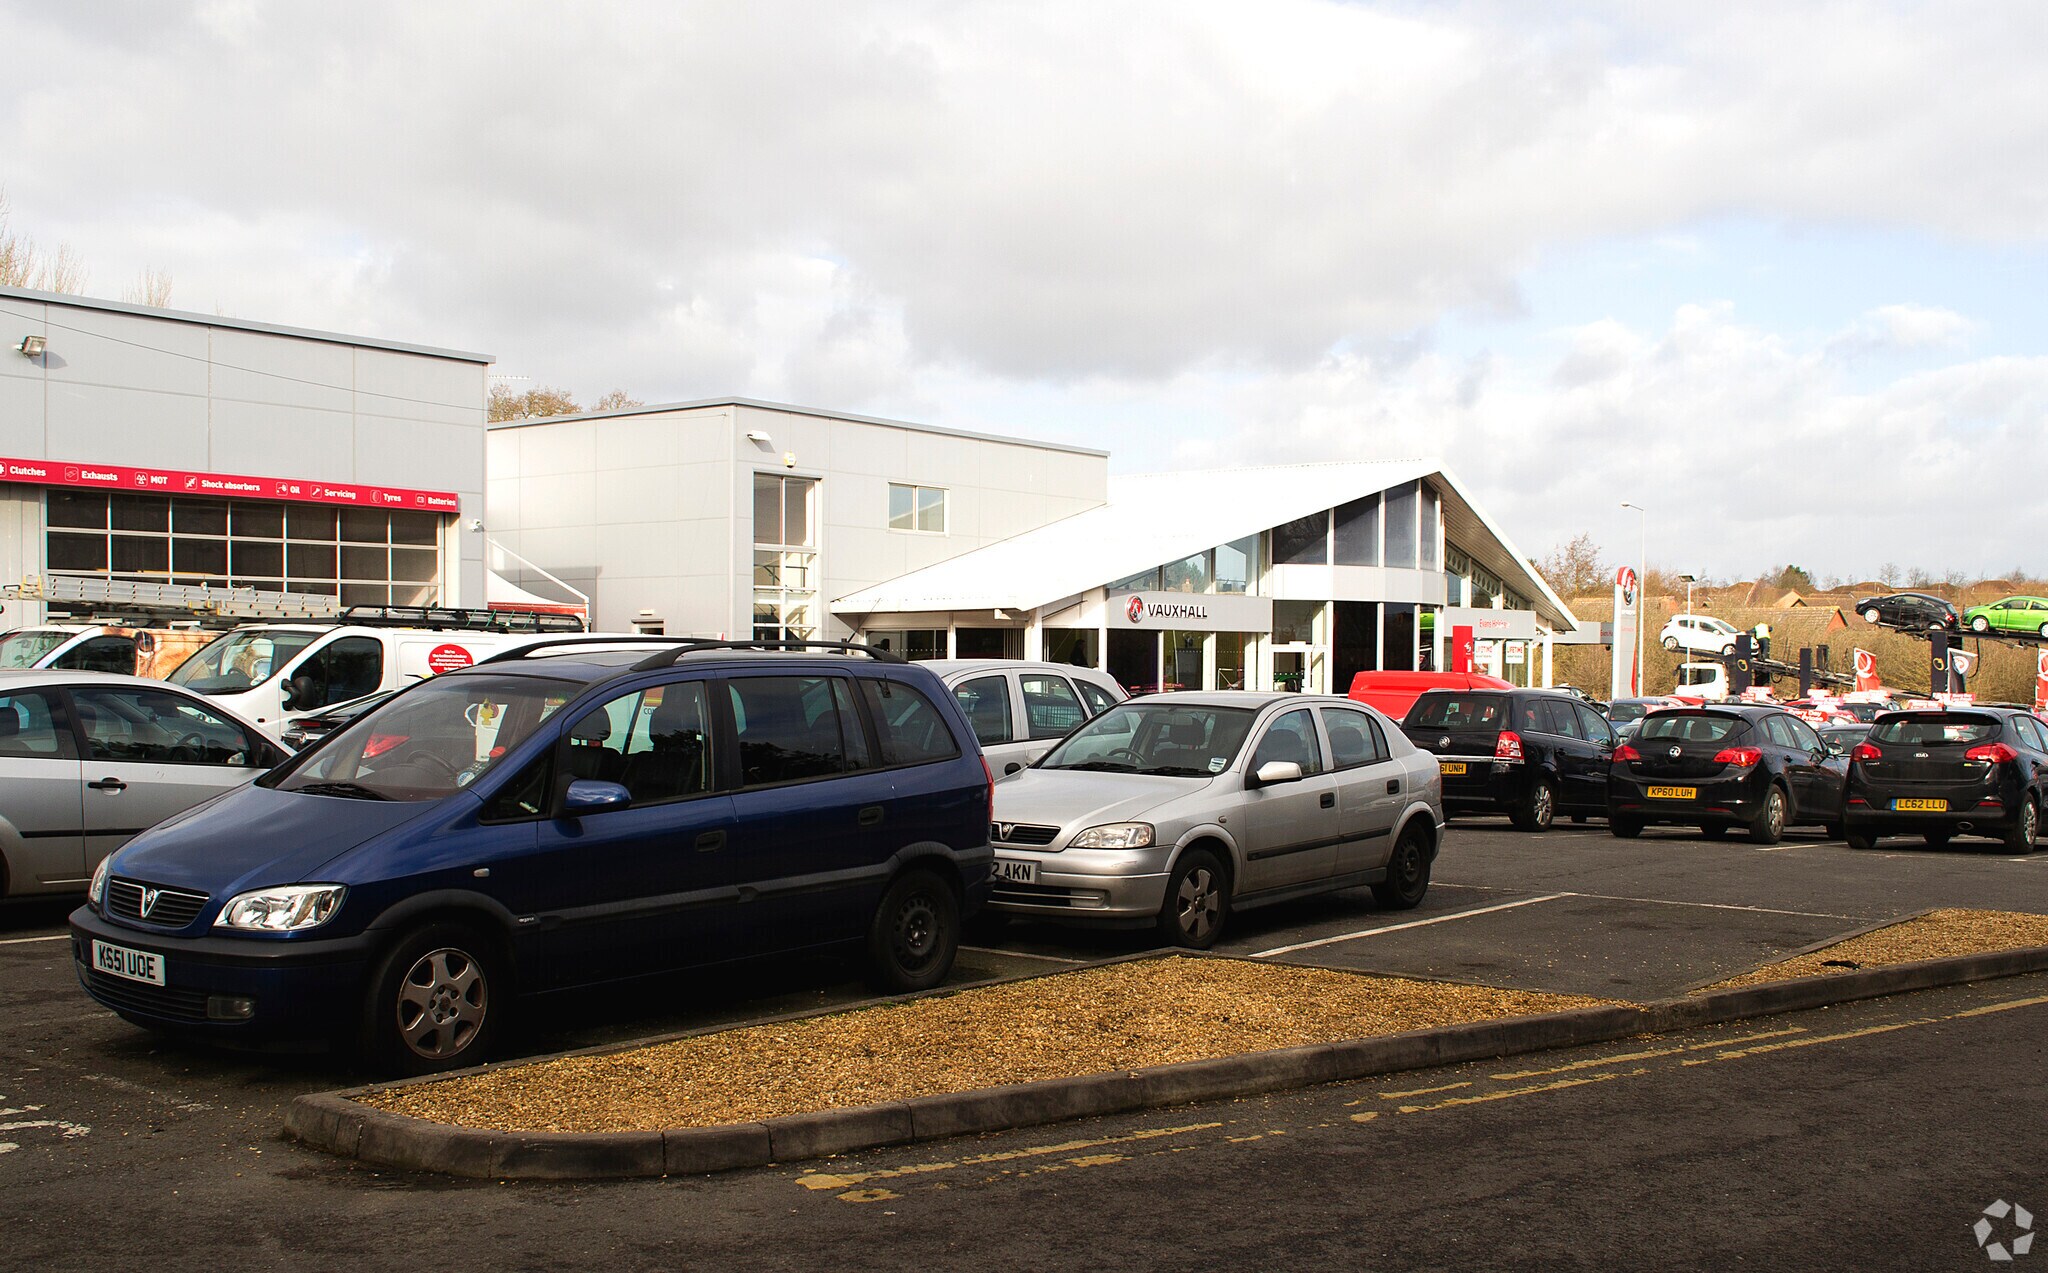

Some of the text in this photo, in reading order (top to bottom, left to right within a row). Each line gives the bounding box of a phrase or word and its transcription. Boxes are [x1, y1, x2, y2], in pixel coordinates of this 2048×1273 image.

[9, 466, 46, 476] Clutches
[81, 471, 118, 481] Exhausts
[150, 476, 168, 484] MOT
[201, 480, 260, 491] Shock absorbers
[290, 485, 300, 494] Oil
[324, 489, 356, 500] Servicing
[383, 493, 401, 502] Tyres
[427, 497, 456, 506] Batteries
[1147, 603, 1208, 618] VAUXHALL
[1448, 763, 1464, 772] UNH
[1651, 787, 1693, 797] KP60 LUH
[1899, 800, 1945, 809] LC62 LLU
[1004, 862, 1031, 881] AKN
[98, 944, 156, 980] KS51 UOE
